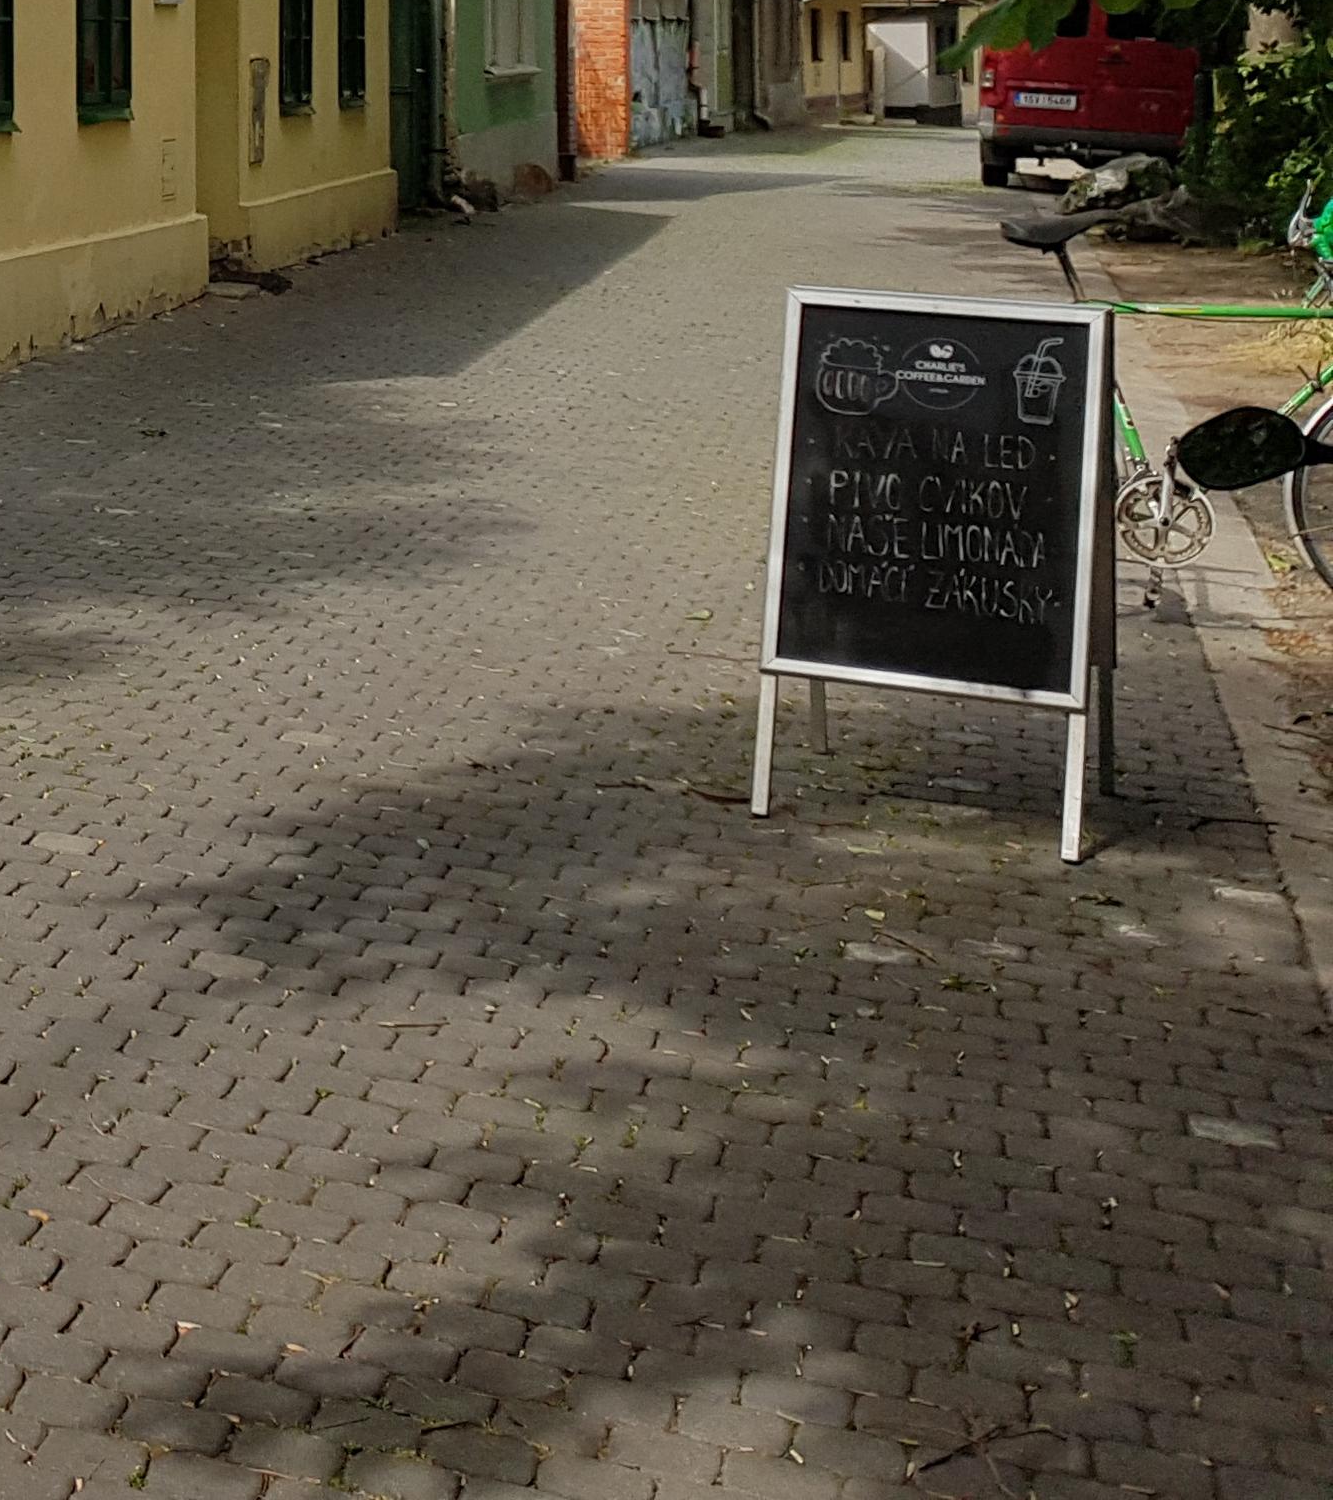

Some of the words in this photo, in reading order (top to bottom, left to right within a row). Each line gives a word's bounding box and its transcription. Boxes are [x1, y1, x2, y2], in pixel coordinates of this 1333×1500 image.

[915, 360, 967, 373] CHARLIE'S
[983, 434, 1036, 470] LED
[829, 469, 901, 510] PIVO
